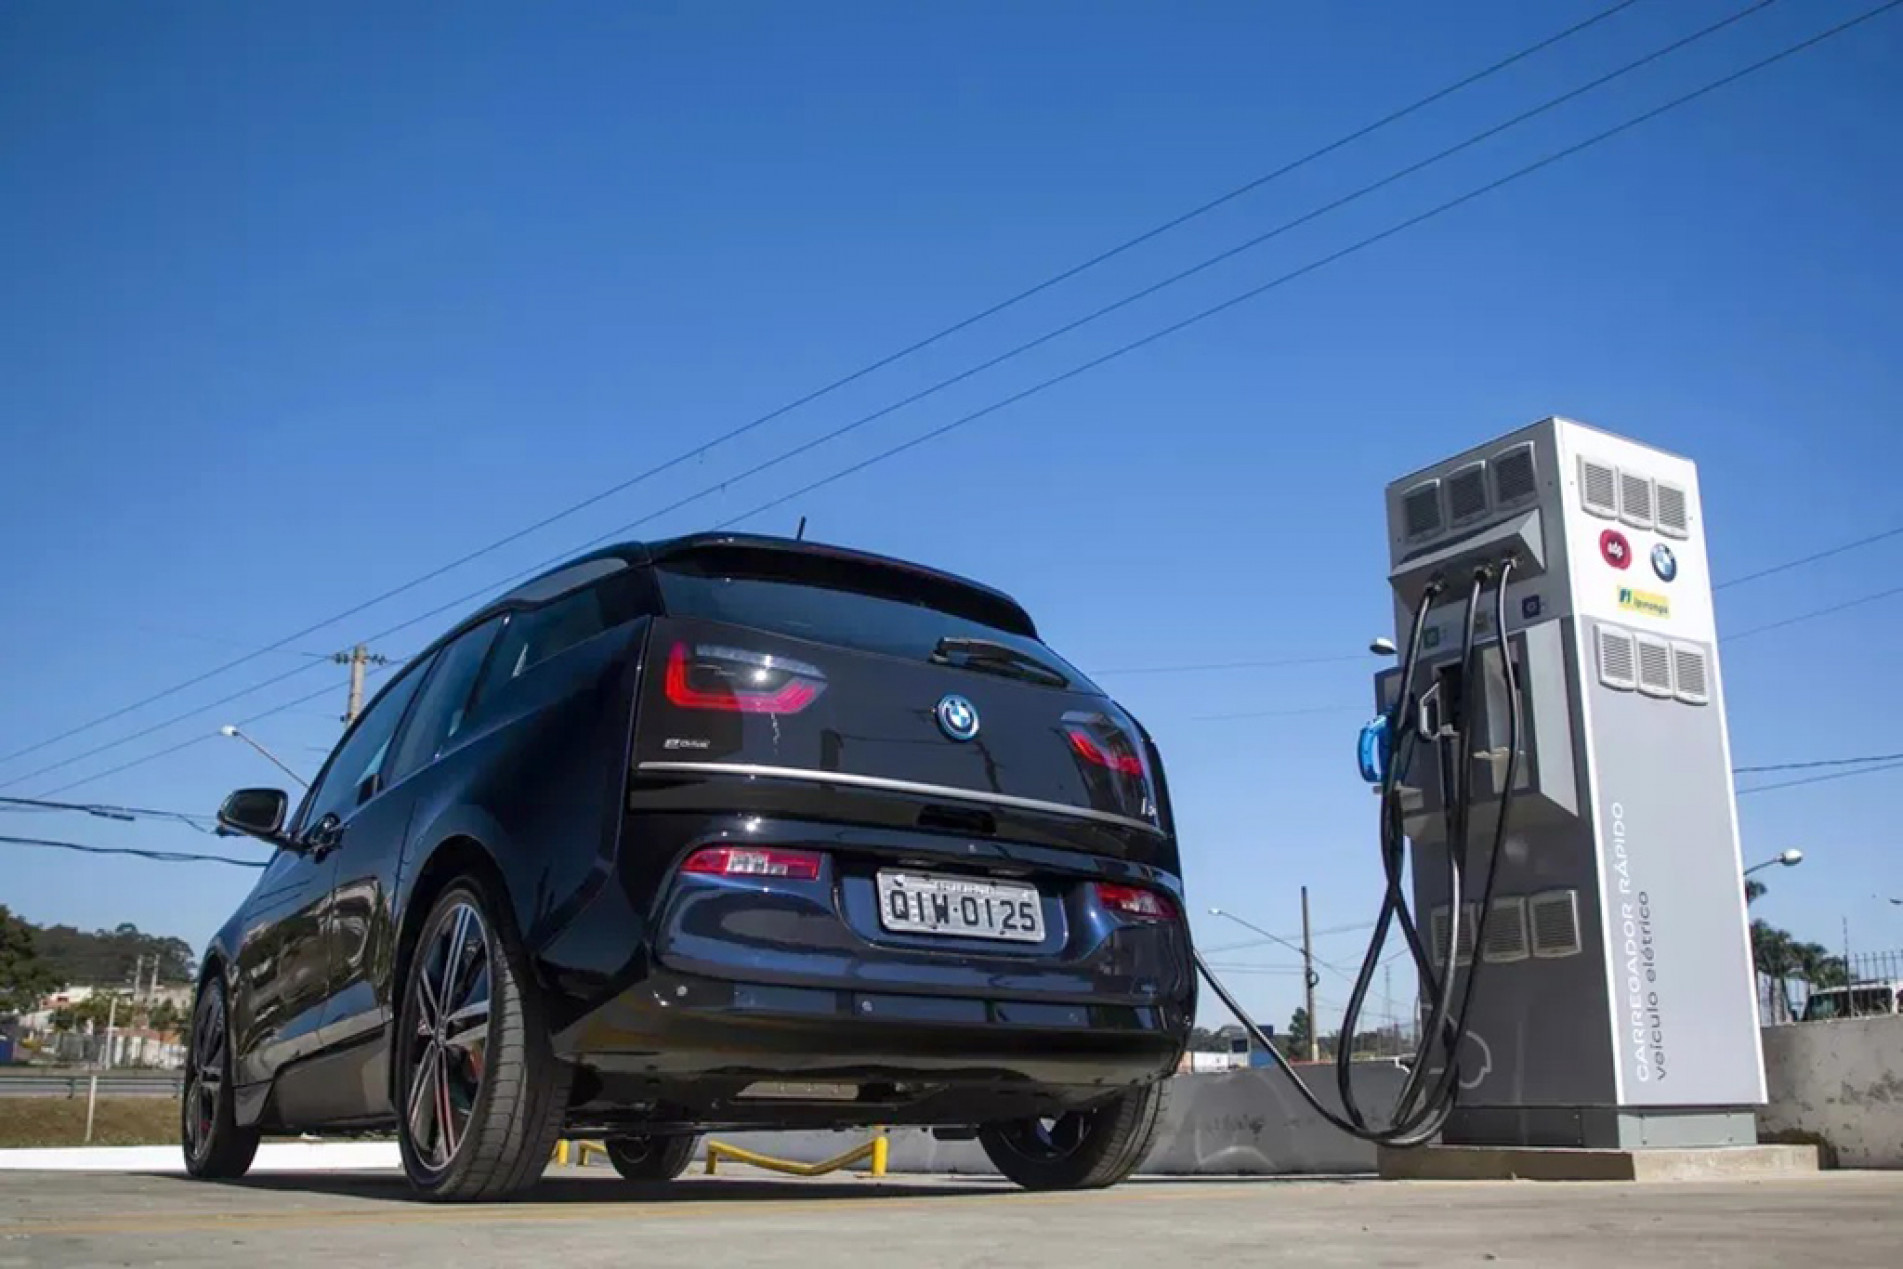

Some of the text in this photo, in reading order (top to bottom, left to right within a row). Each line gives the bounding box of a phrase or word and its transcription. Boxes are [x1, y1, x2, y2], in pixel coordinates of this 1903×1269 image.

[1613, 801, 1649, 1082] CARREGADOR RÁPIDO
[1638, 891, 1667, 1081] veículo elétrico
